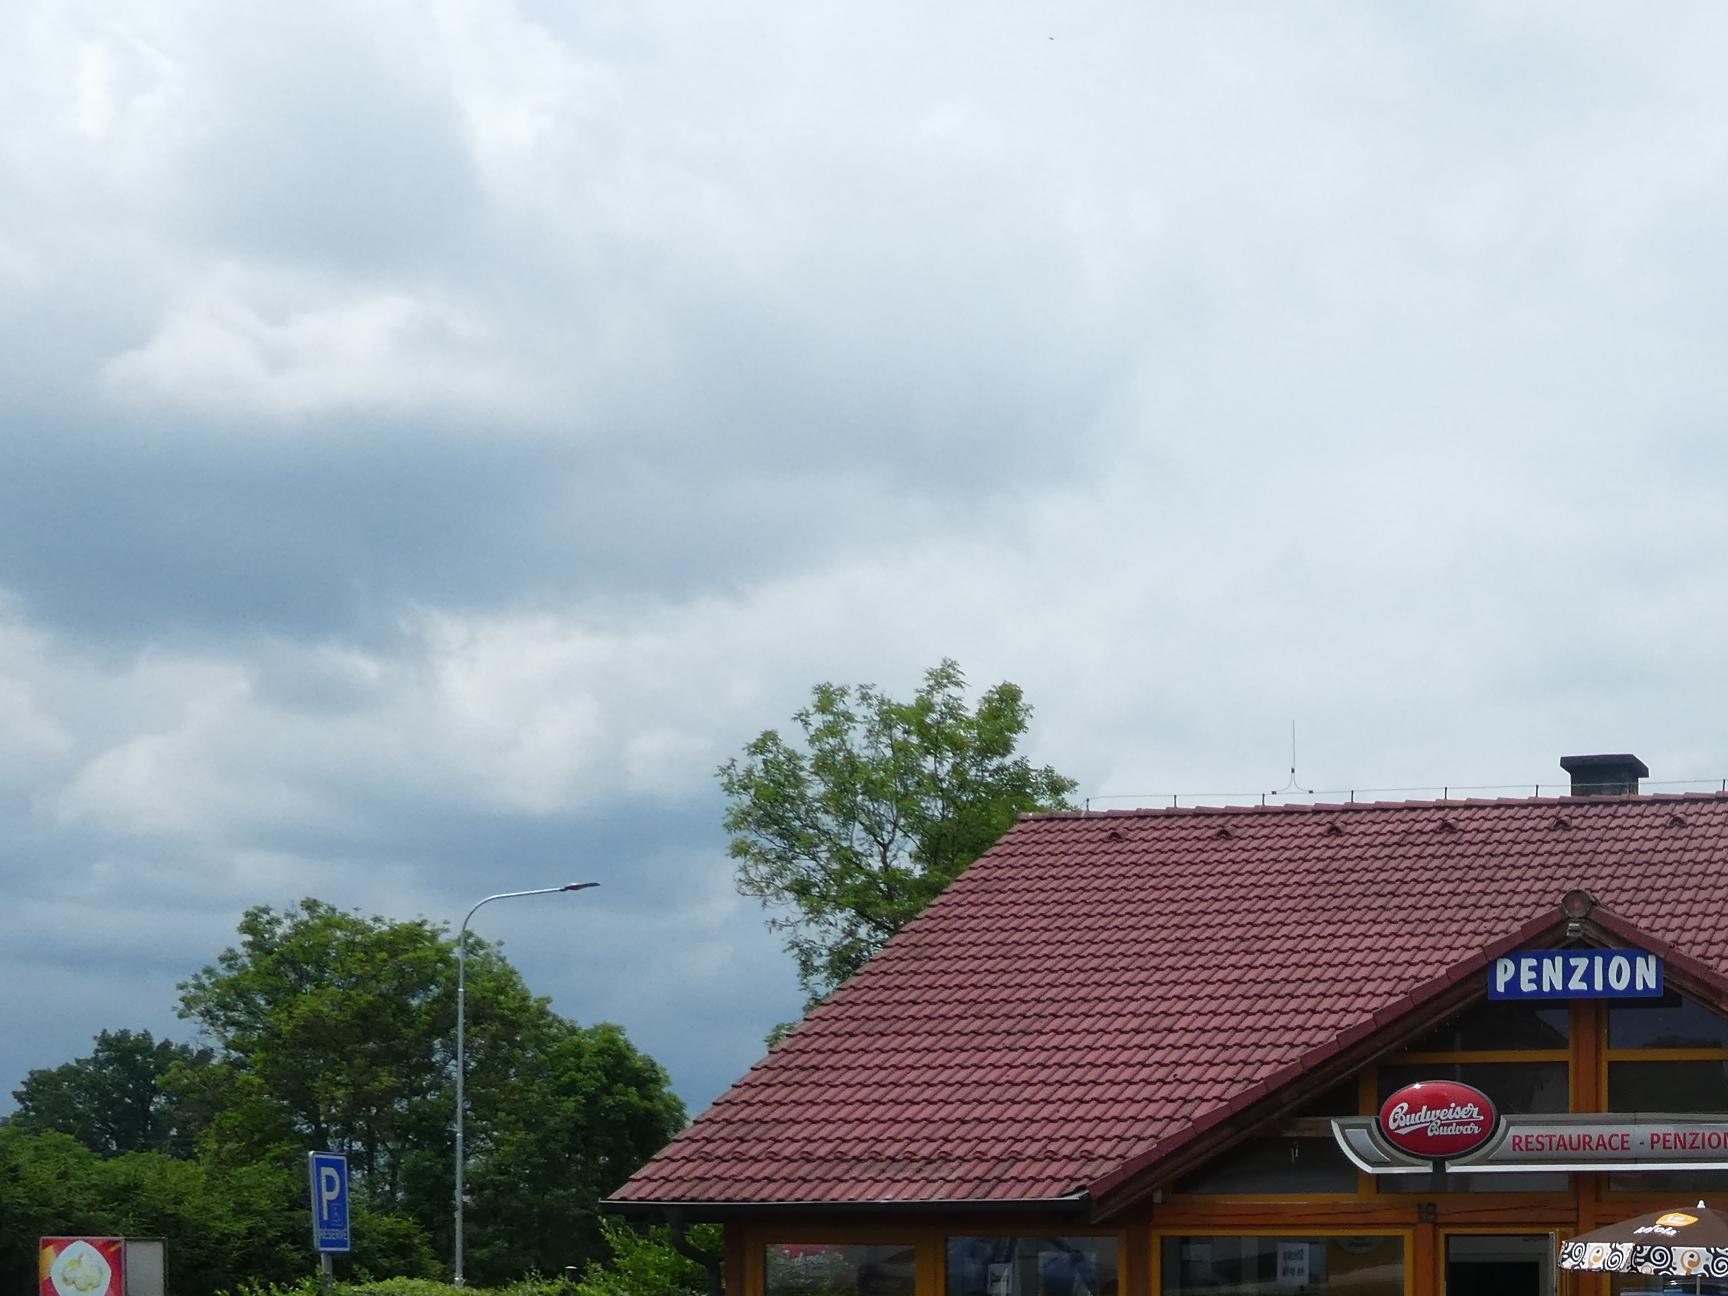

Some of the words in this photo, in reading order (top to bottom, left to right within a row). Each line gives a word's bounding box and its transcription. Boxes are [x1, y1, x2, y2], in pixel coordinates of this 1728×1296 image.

[1496, 955, 1657, 993] PENZION
[1389, 1102, 1484, 1132] Budweiser
[1427, 1119, 1482, 1136] Budvar
[1511, 1133, 1631, 1151] RESTAURACE
[320, 1166, 341, 1221] P
